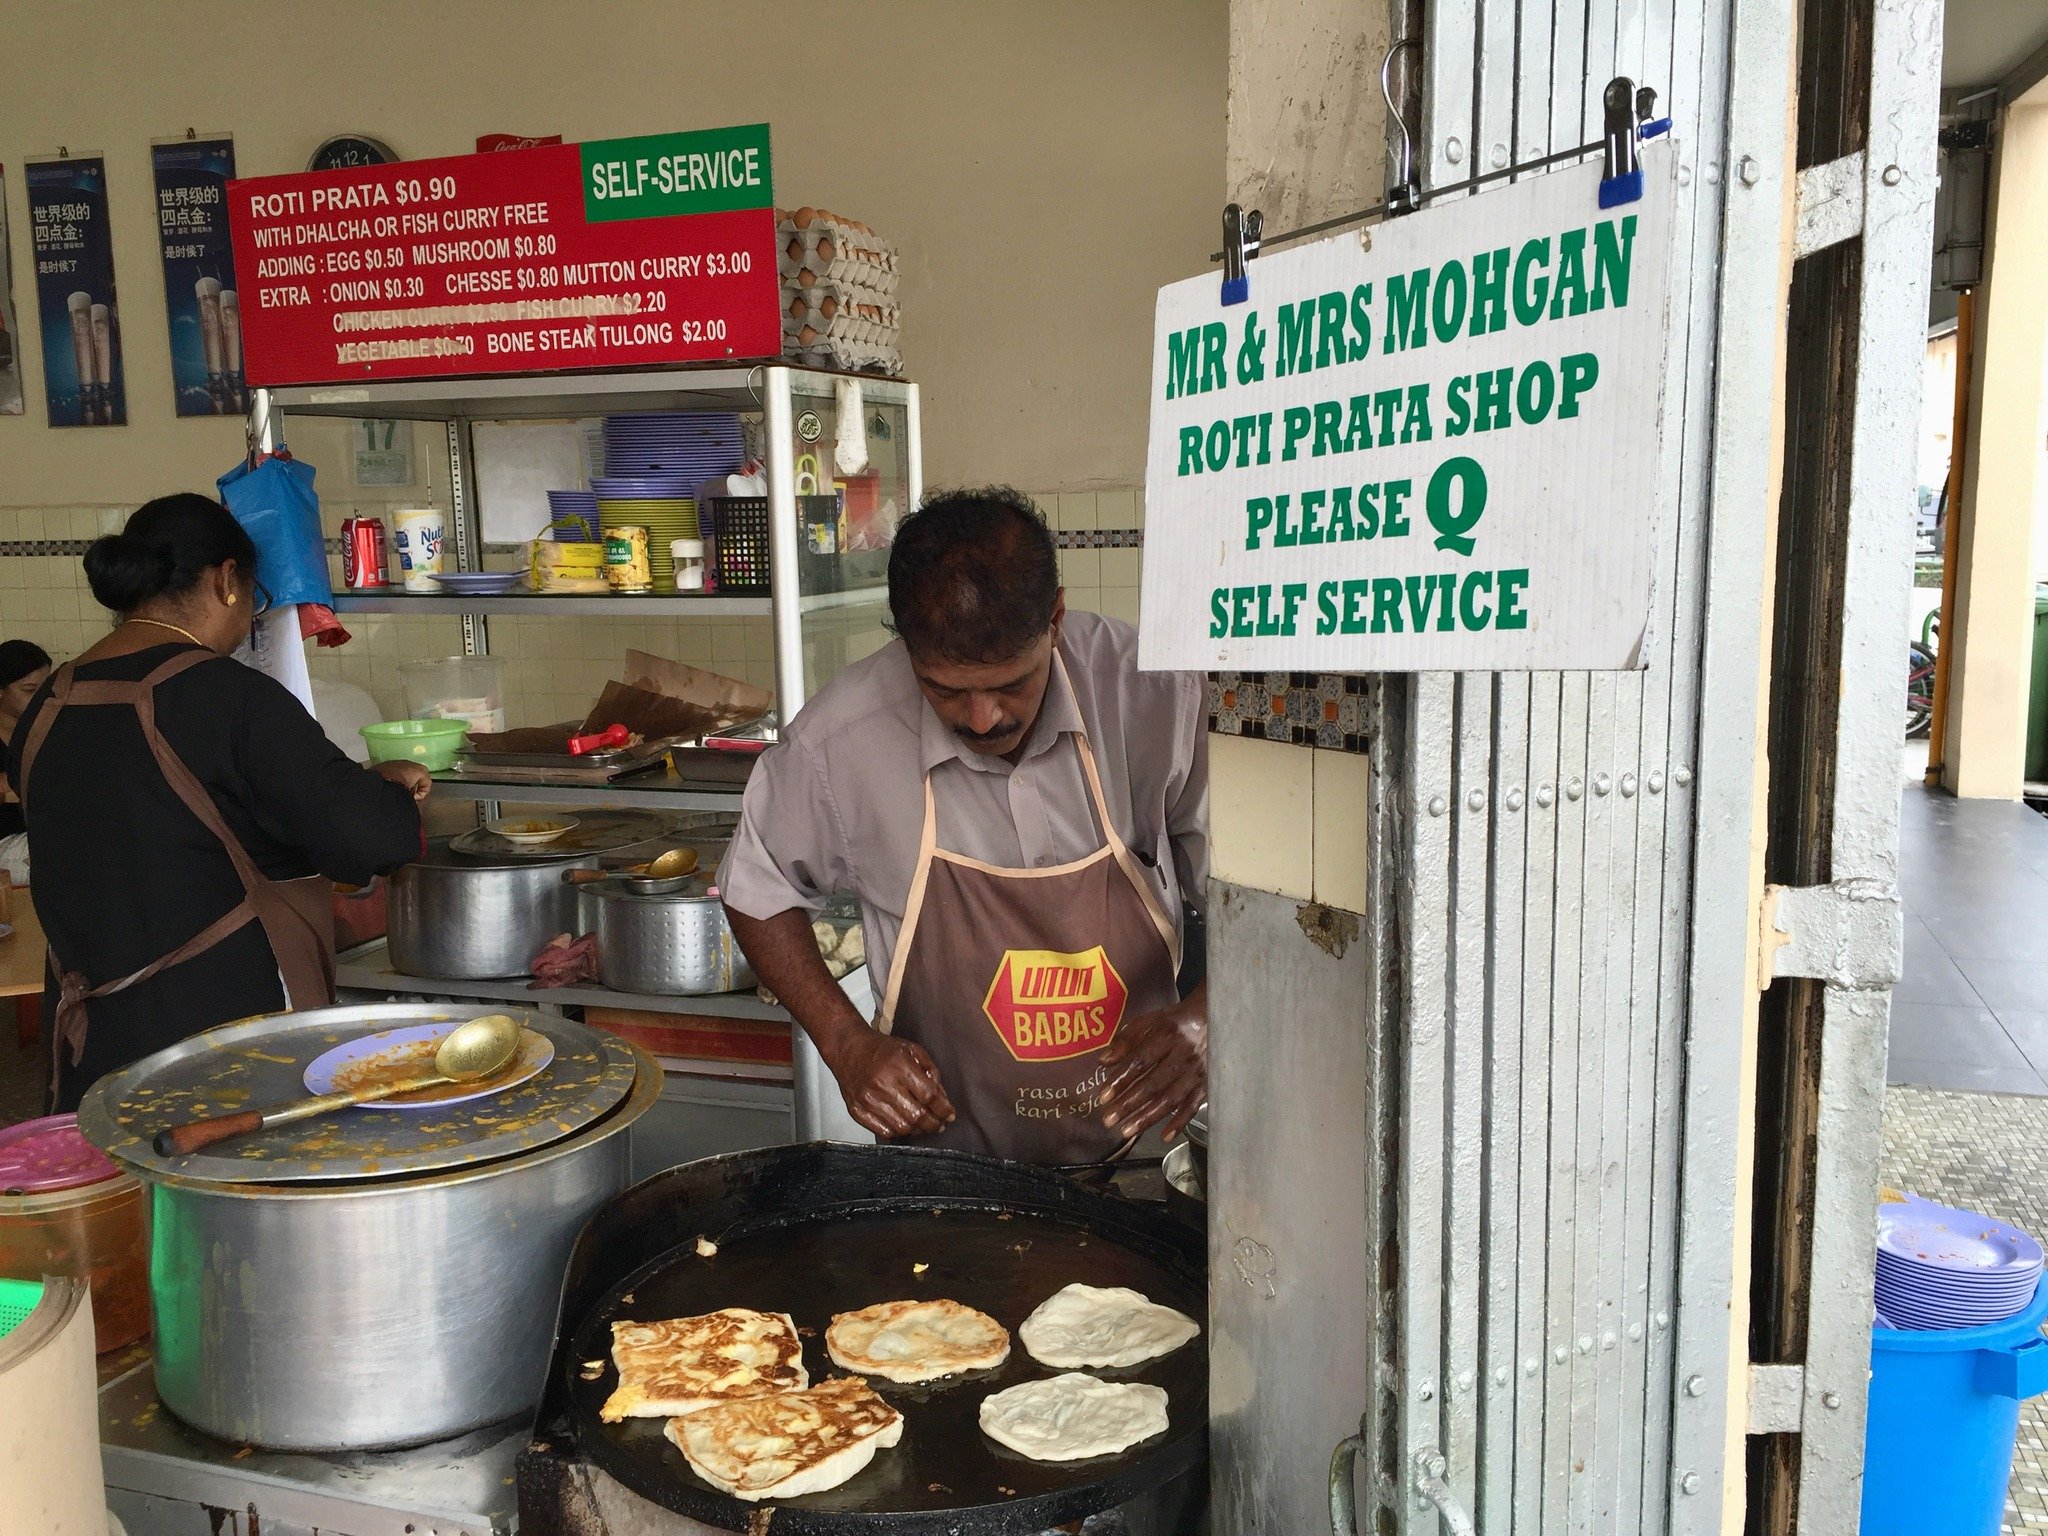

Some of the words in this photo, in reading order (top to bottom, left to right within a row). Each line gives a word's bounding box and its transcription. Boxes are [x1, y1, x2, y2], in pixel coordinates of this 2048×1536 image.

[344, 150, 360, 166] 12
[591, 148, 761, 200] SELF-SERVICE
[33, 202, 91, 223] 世界级的
[160, 184, 219, 207] 世界级的
[251, 191, 305, 218] ROTI
[312, 183, 389, 212] PRATA
[396, 176, 457, 206] $0.90
[254, 226, 293, 248] WITH
[296, 218, 371, 245] DHALCHA
[374, 216, 399, 238] OR
[403, 211, 440, 236] FISH
[442, 207, 499, 232] CURRY
[504, 202, 549, 226] FREE
[39, 259, 77, 274] 是时候了
[165, 243, 206, 259] 是时候了
[258, 256, 316, 278] ADDING
[327, 251, 361, 273] EGG
[365, 247, 404, 272] $0.50
[412, 238, 511, 266] MUSHROOM
[514, 234, 557, 260] $0.80
[260, 286, 311, 308] EXTRA
[330, 280, 381, 303] ONION
[384, 276, 425, 301] $0.30
[446, 269, 513, 294] CHESSE
[517, 266, 559, 291] $0.80
[563, 260, 636, 286] MUTTON
[640, 254, 702, 279] CURRY
[706, 251, 751, 277] $3.00
[515, 299, 555, 319] FISH
[622, 290, 667, 316] $2.20
[1166, 321, 1227, 400] MR
[1237, 310, 1267, 386] &
[1275, 282, 1373, 378] MRS
[1383, 214, 1638, 356] MOHGAN
[335, 337, 430, 363] VEGETABLE
[487, 331, 536, 354] BONE
[539, 325, 597, 350] STEAK
[600, 322, 673, 347] TULONG
[682, 318, 727, 344] $2.00
[363, 420, 396, 450] 17
[1177, 412, 1273, 477] ROTI
[1282, 383, 1433, 462] PRATA
[1445, 351, 1600, 438] SHOP
[1245, 479, 1411, 551] PLEASE
[1425, 456, 1488, 557] Q
[1209, 582, 1307, 640] SELF
[1316, 568, 1530, 636] SERVICE
[1013, 1005, 1105, 1047] BABA'S
[1016, 1086, 1069, 1100] rasa
[1075, 1065, 1108, 1095] asli
[1015, 1099, 1062, 1119] kari
